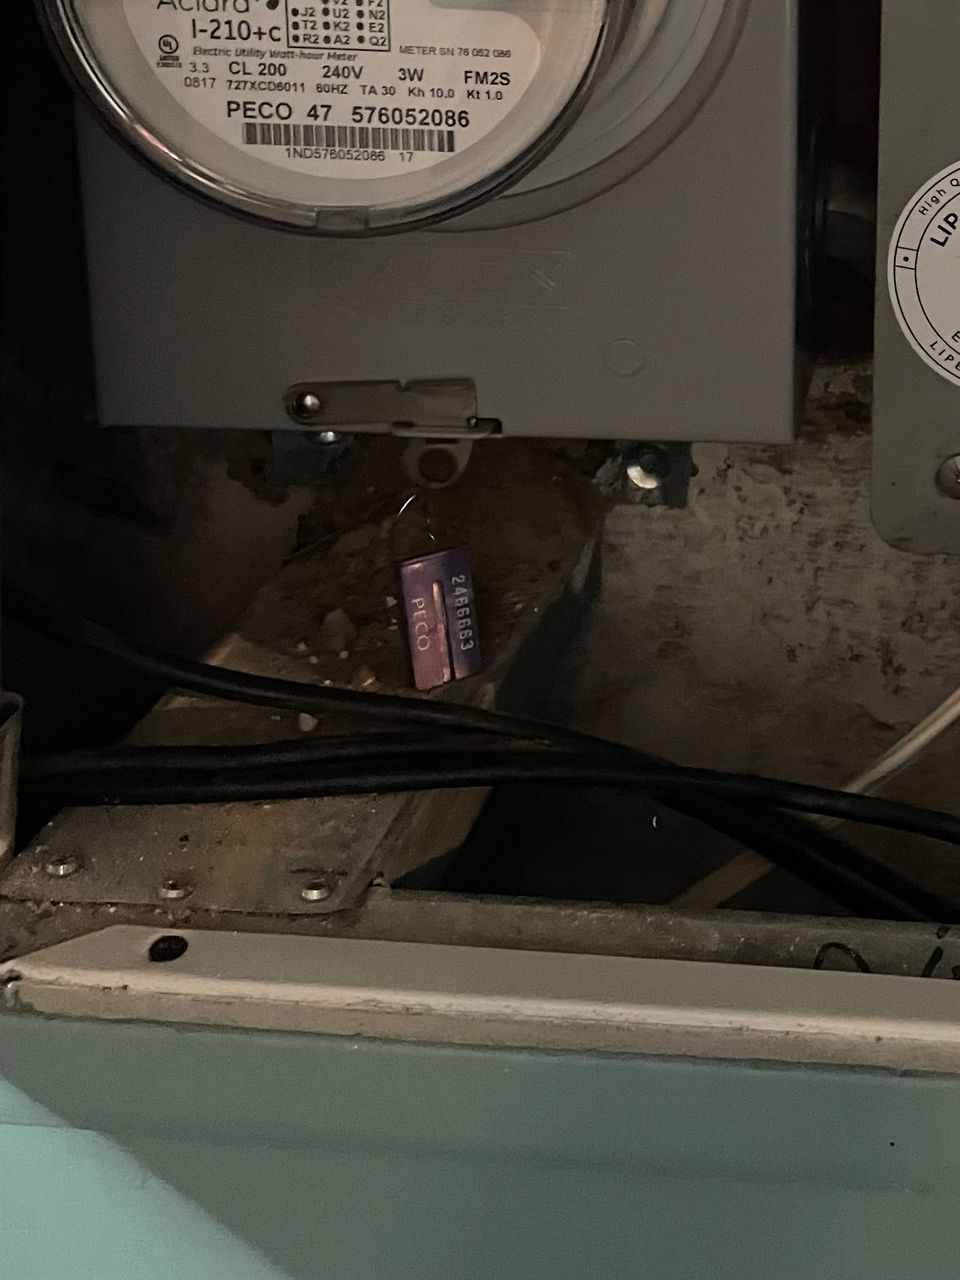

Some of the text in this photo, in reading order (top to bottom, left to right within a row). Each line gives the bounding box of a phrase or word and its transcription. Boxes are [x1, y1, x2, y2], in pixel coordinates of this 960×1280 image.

[301, 6, 316, 17] J2
[333, 8, 350, 19] U2
[369, 10, 386, 20] N2
[192, 18, 282, 43] I-210+c
[302, 20, 317, 30] T2
[333, 21, 350, 31] K2
[369, 22, 385, 33] E2
[303, 33, 320, 44] R2
[334, 35, 350, 45] A2
[369, 36, 387, 46] Q2
[193, 47, 359, 61] Electric Utility Watt-hour Meter
[400, 46, 437, 55] METER
[439, 47, 455, 56] SN
[472, 48, 490, 57] 052
[228, 61, 253, 75] CL
[258, 62, 287, 76] 200
[322, 65, 364, 79] 240V
[398, 68, 425, 82] 3W
[464, 70, 511, 86] FM2S
[316, 83, 349, 94] 60HZ
[360, 85, 378, 96] TA
[381, 86, 396, 96] 30
[408, 87, 425, 97] Kh
[430, 88, 455, 98] 10.0
[467, 89, 480, 100] Kt
[485, 90, 503, 100] 1.0
[227, 100, 470, 127] PECO 47 576052086
[399, 152, 414, 162] 17
[919, 187, 947, 216] High
[929, 212, 960, 247] LIP
[411, 597, 430, 651] PECO
